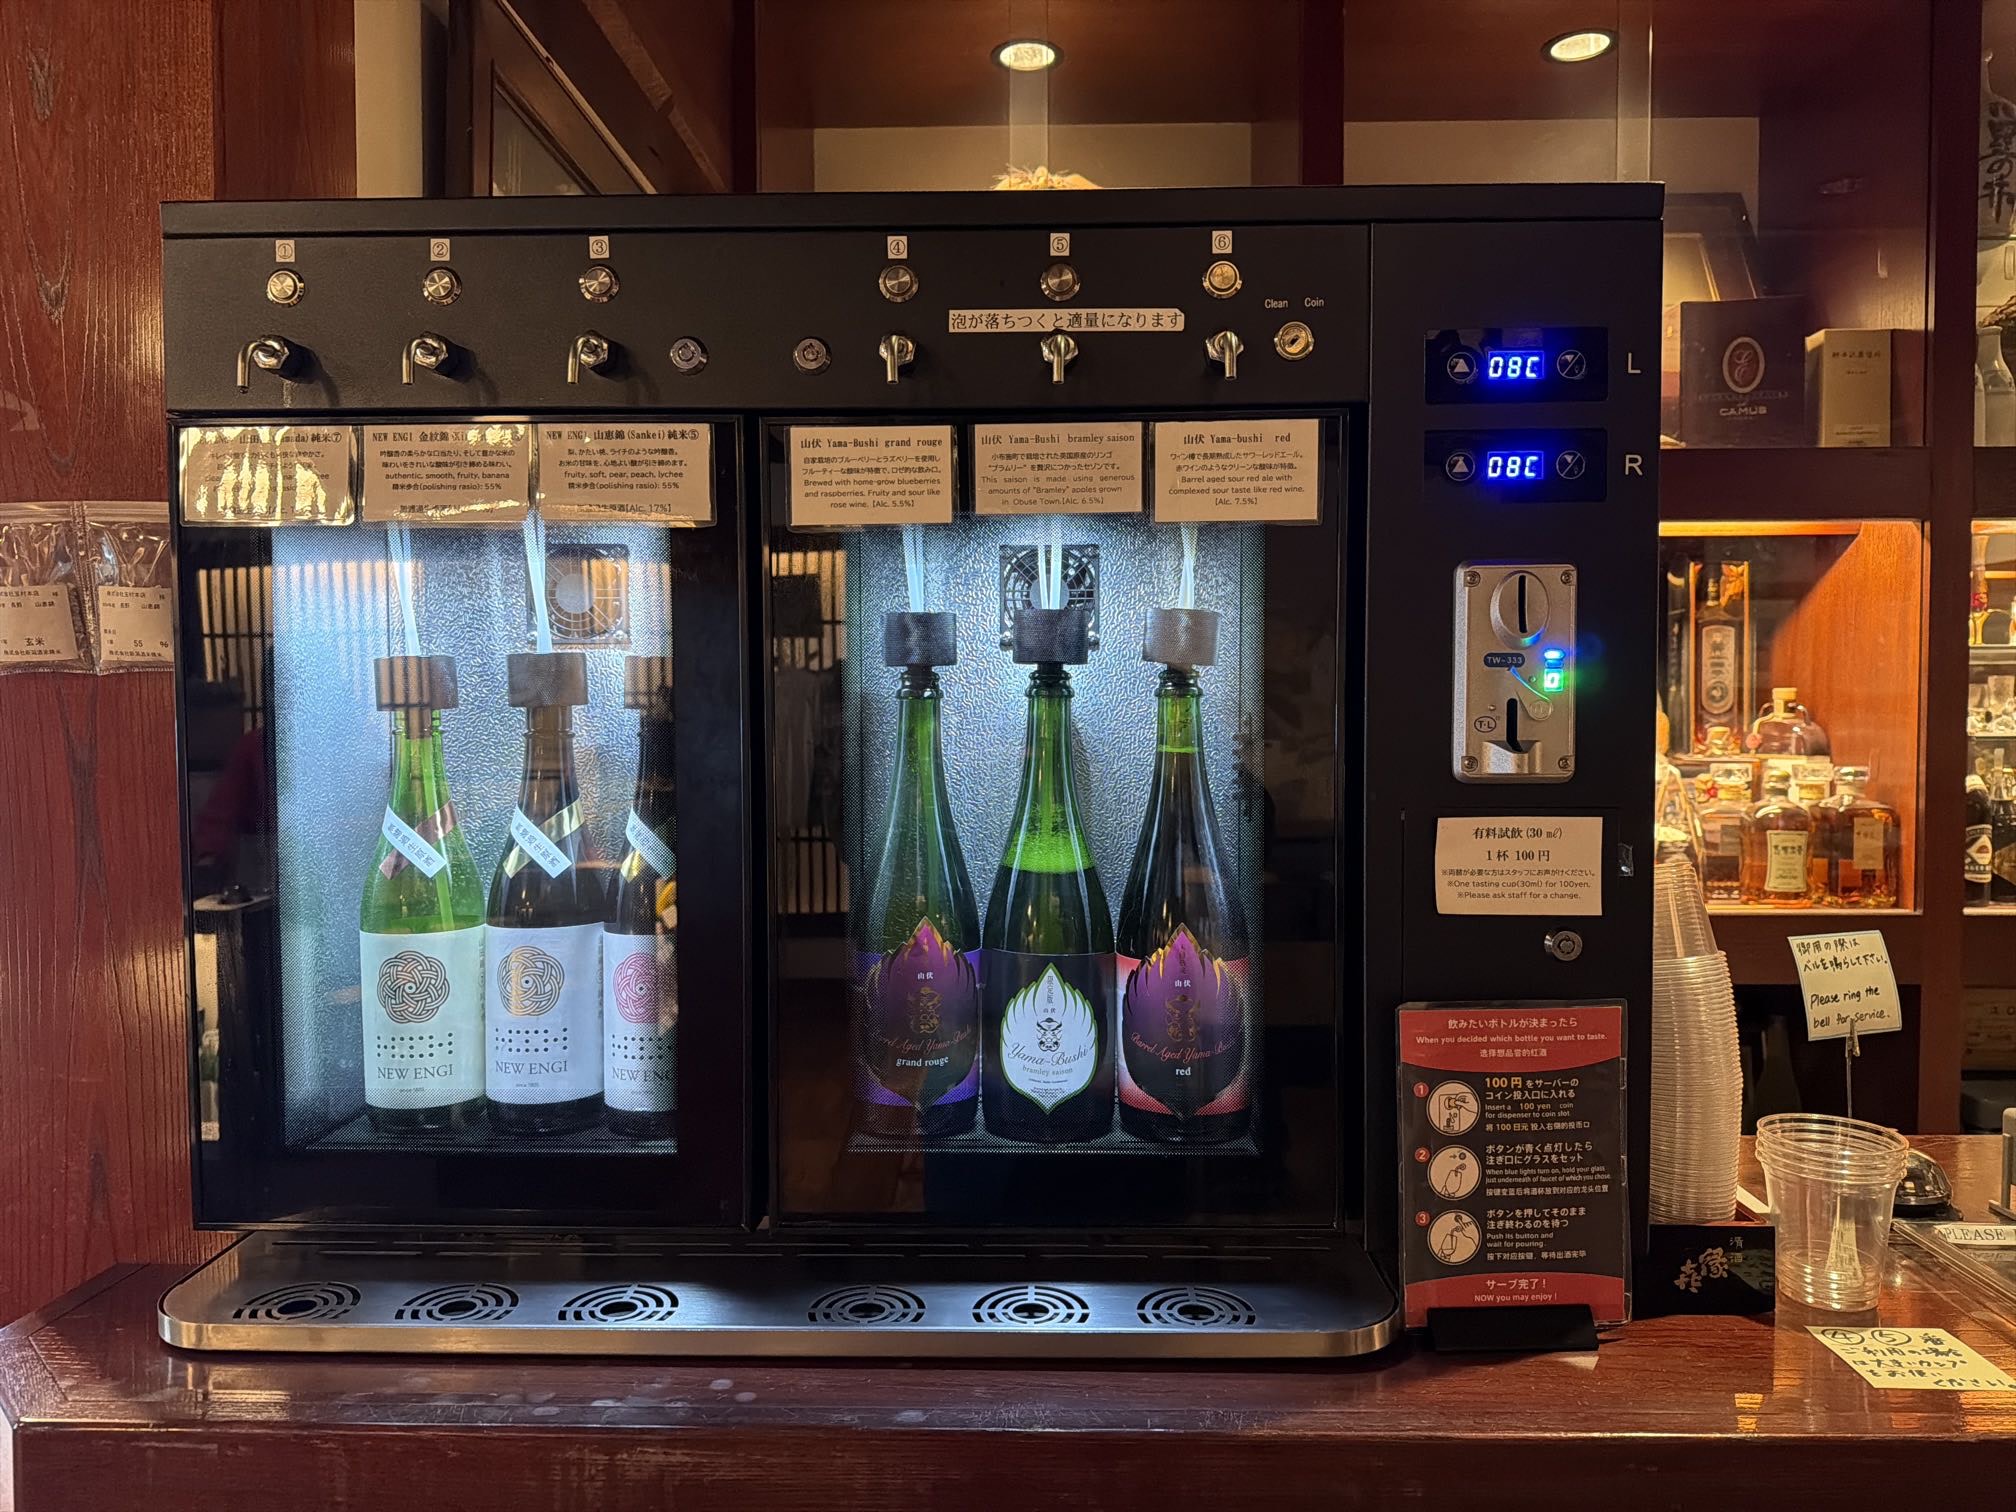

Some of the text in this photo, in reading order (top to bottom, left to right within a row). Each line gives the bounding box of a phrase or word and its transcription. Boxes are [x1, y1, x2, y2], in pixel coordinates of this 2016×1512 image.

[1265, 296, 1324, 309] Clean Coin
[951, 311, 1182, 331] 泡が落ちつくと適量になります
[1628, 352, 1641, 374] L
[1719, 405, 1768, 416] CAMUS
[372, 432, 388, 442] NEW
[800, 437, 943, 449] 山伏 Yama-Bushi grand rouge
[981, 433, 1135, 446] 山伏 Yama-Bushi bramley saison
[1183, 432, 1291, 445] 山伏 Yama-bushi red
[1625, 454, 1643, 475] R
[457, 472, 480, 480] fruity,
[564, 471, 588, 479] fruity,
[589, 471, 607, 479] soft,
[630, 471, 655, 479] peach,
[658, 471, 683, 479] lychee
[981, 476, 998, 484] This
[1003, 475, 1028, 483] saison
[1046, 475, 1067, 483] made
[1073, 475, 1094, 483] using
[1099, 474, 1135, 483] generous
[1181, 475, 1205, 484] Barrel
[1206, 475, 1226, 483] aged
[1246, 474, 1260, 482] red
[1261, 474, 1273, 482] ale
[853, 478, 895, 487] home-grow
[897, 477, 941, 485] blueberries
[804, 490, 819, 498] and
[820, 490, 865, 499] raspberries.
[868, 489, 890, 498] Fruity
[891, 489, 906, 497] and
[927, 488, 941, 496] like
[988, 487, 1021, 495] amounts
[1022, 486, 1031, 494] of
[1071, 486, 1097, 494] apples
[1099, 486, 1123, 494] grown
[1168, 487, 1210, 496] complexed
[1284, 485, 1305, 493] wine.
[1486, 656, 1522, 664] TW-333
[1472, 880, 1500, 889] tasting
[1501, 880, 1543, 889] cup(30ml)
[1545, 880, 1558, 888] for
[1559, 880, 1590, 889] 100yen.
[1492, 891, 1506, 899] ask
[1507, 891, 1527, 899] staff
[1529, 891, 1541, 899] for
[1549, 891, 1581, 900] change.
[1796, 938, 1860, 956] 御用の際は
[917, 971, 934, 980] 山伏
[1174, 979, 1191, 988] 山伏
[1810, 985, 1880, 1010] Please ring the
[1447, 1017, 1579, 1030] 飲みたいボトルが決まったら
[1813, 1008, 1890, 1029] bell for service.
[1415, 1033, 1608, 1045] When you decided which bottle you want to taste.
[1007, 1042, 1089, 1066] Yama-Bushi
[495, 1060, 568, 1075] NEW ENGI
[896, 1056, 949, 1067] grand rouge
[377, 1063, 454, 1081] NEW ENGI
[612, 1066, 640, 1082] NEW
[1022, 1064, 1074, 1077] bramley saison
[1175, 1066, 1192, 1076] red
[1485, 1089, 1576, 1100] コイン投入口に入れる
[1485, 1103, 1506, 1111] Insert
[1519, 1102, 1534, 1111] 100
[1536, 1103, 1552, 1112] yen
[1485, 1111, 1496, 1119] for
[1497, 1111, 1531, 1120] dispenser
[1541, 1110, 1556, 1118] coin
[1485, 1141, 1593, 1154] ボタンが青く点灯したら
[1485, 1153, 1584, 1165] 注ぎ口にグラスをセット
[1486, 1206, 1587, 1218] ボタンを押してそのまま
[1486, 1218, 1569, 1230] 注ぎ終わるのを待つ
[1943, 1227, 2007, 1241] PLEASE
[1486, 1240, 1503, 1248] wait
[1503, 1240, 1514, 1248] for
